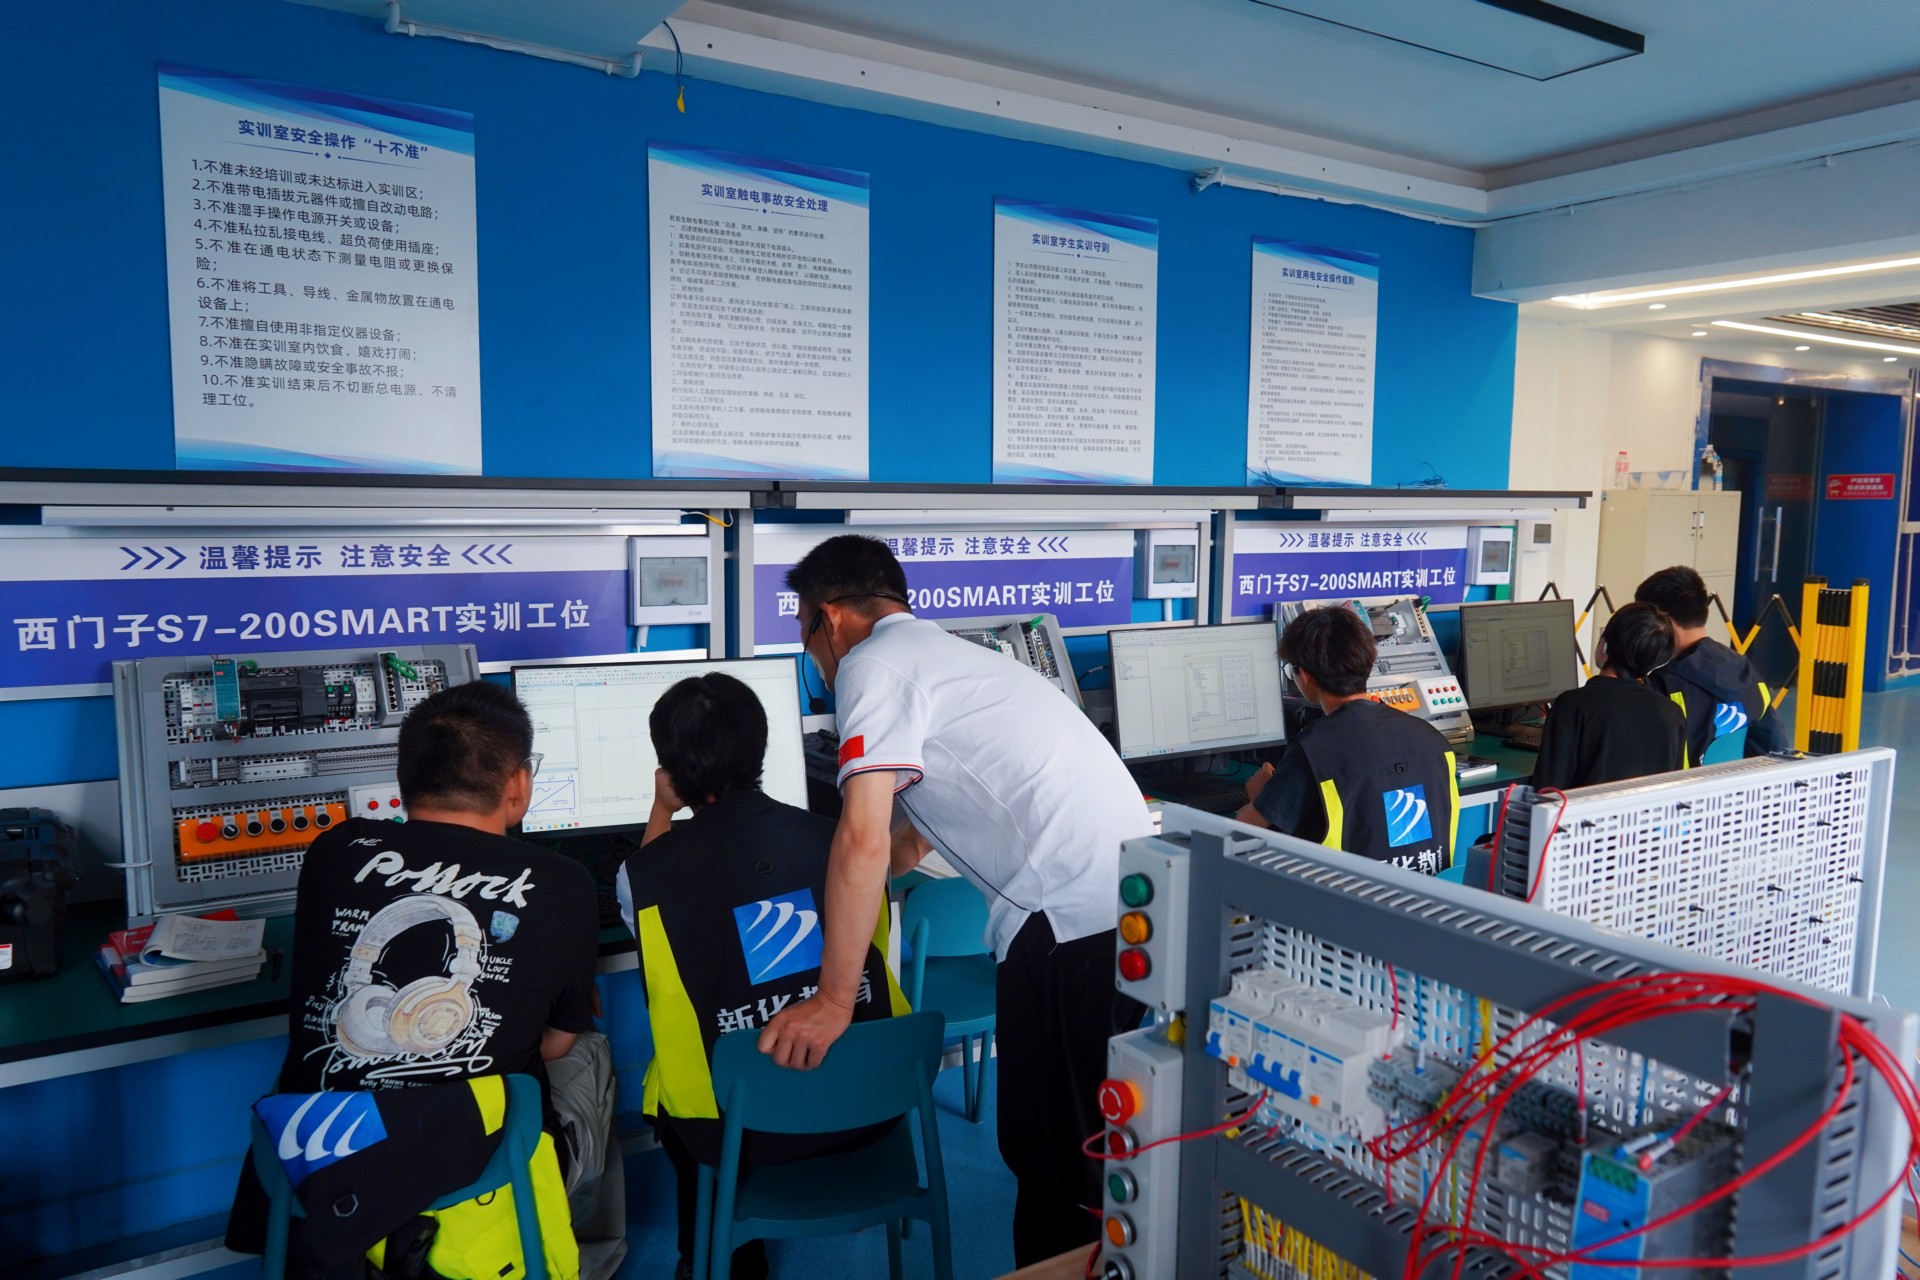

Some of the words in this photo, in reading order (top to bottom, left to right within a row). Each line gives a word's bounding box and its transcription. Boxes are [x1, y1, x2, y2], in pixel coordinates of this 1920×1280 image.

[701, 183, 828, 212] 实训室触电事故安全处理
[1032, 232, 1110, 254] 实训室学生实训守则
[1282, 267, 1355, 286] 实训室用电安全操作规则
[884, 537, 955, 556] 温馨提示
[965, 536, 1031, 555] 注意安全
[1307, 532, 1355, 548] 温馨提示
[1360, 532, 1404, 547] 注意安全
[199, 545, 323, 571] 温馨提示
[340, 543, 453, 569] 注意安全
